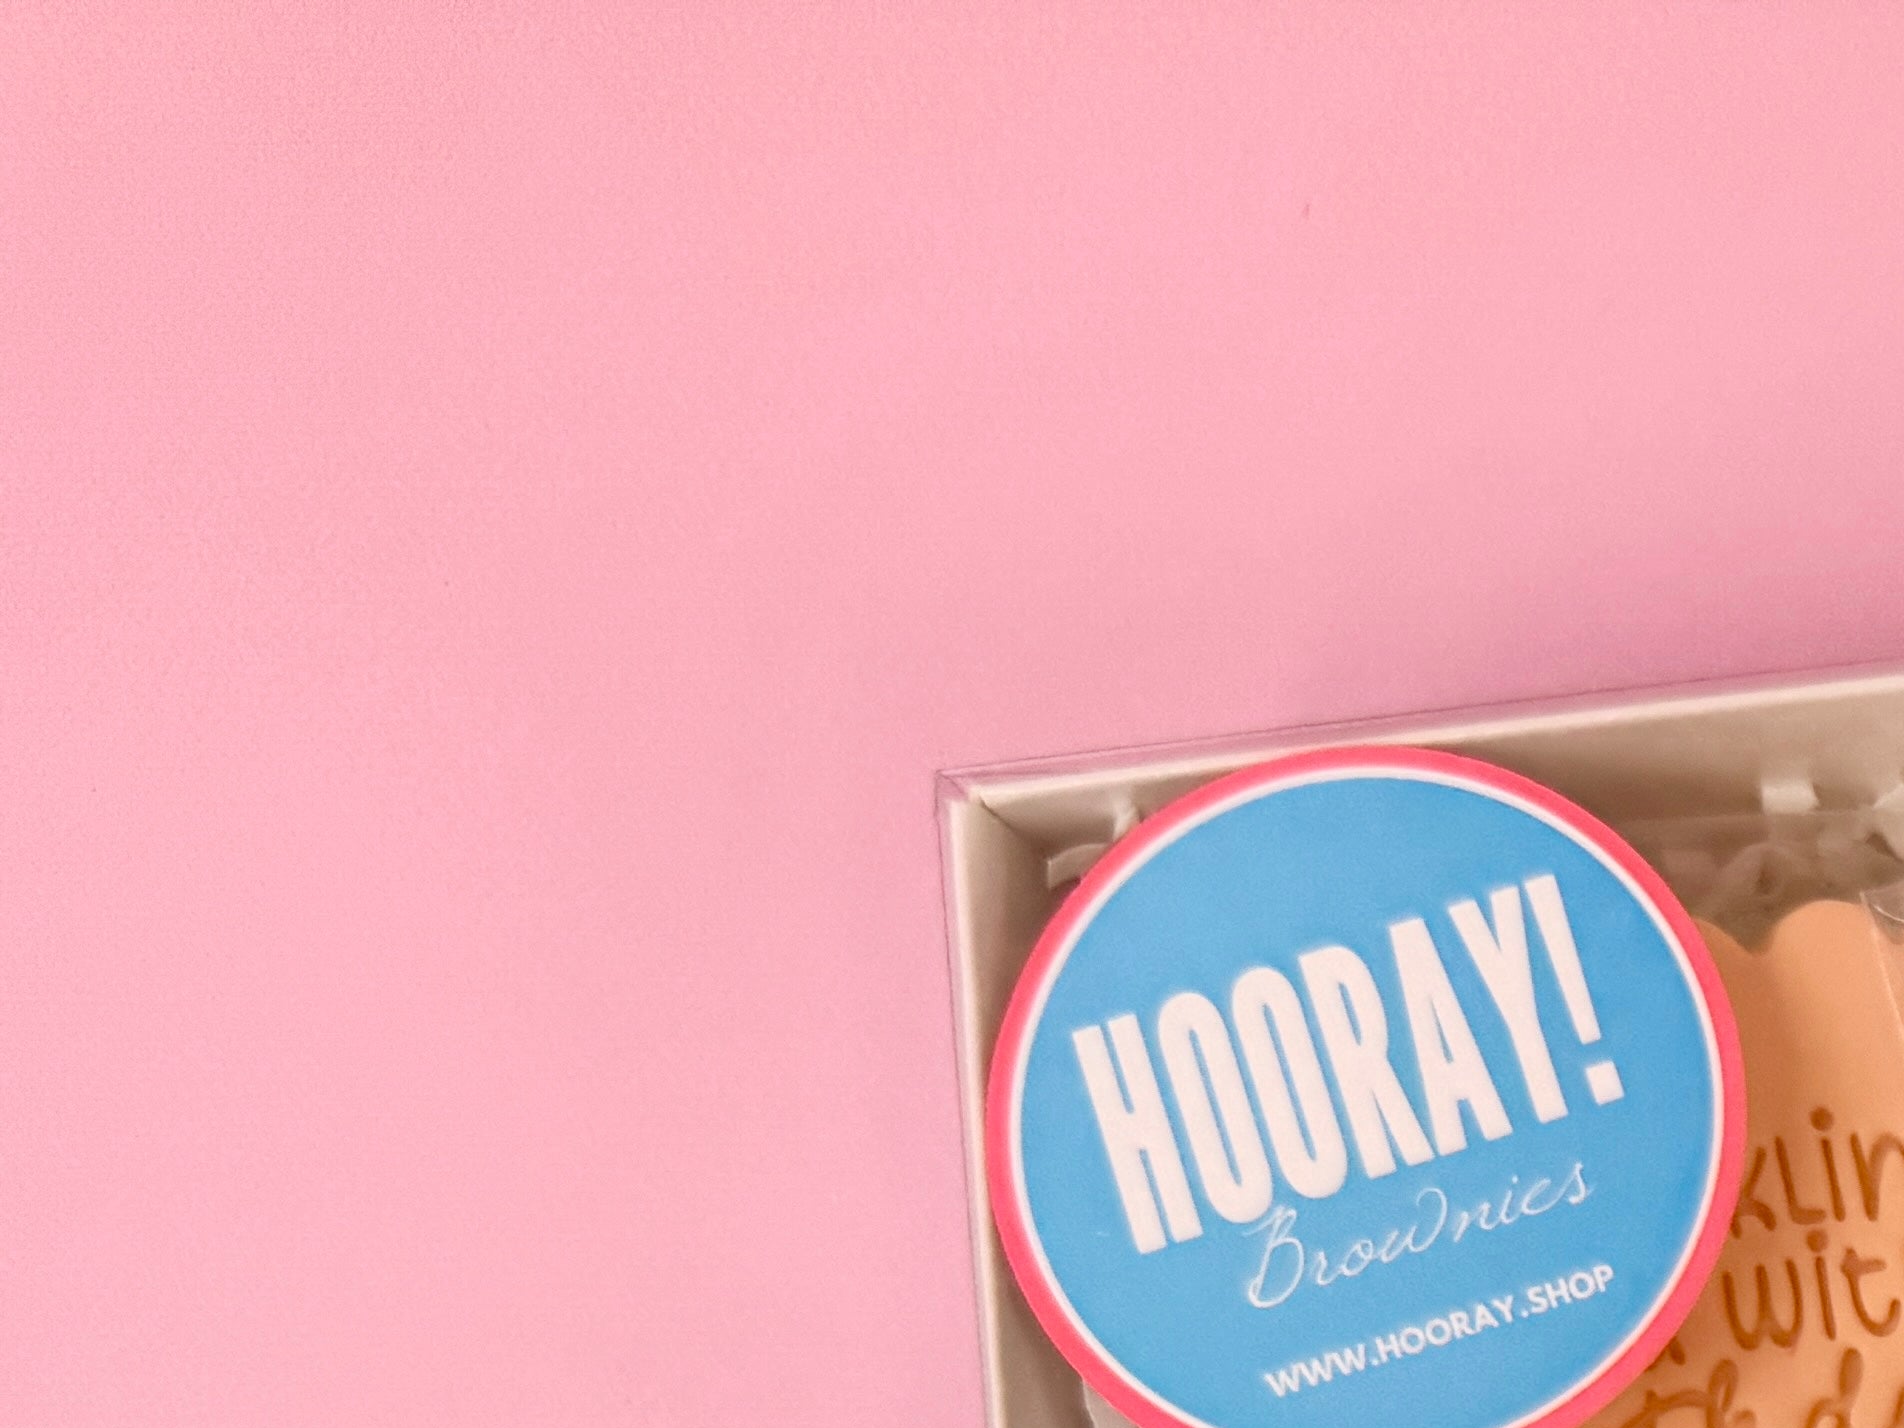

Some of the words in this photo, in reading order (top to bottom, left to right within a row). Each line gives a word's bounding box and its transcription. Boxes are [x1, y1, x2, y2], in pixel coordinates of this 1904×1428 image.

[1072, 873, 1626, 1256] HOORAY!
[1243, 1162, 1597, 1310] Brownies
[1263, 1263, 1616, 1398] WWW.HOORAY.SHOP
